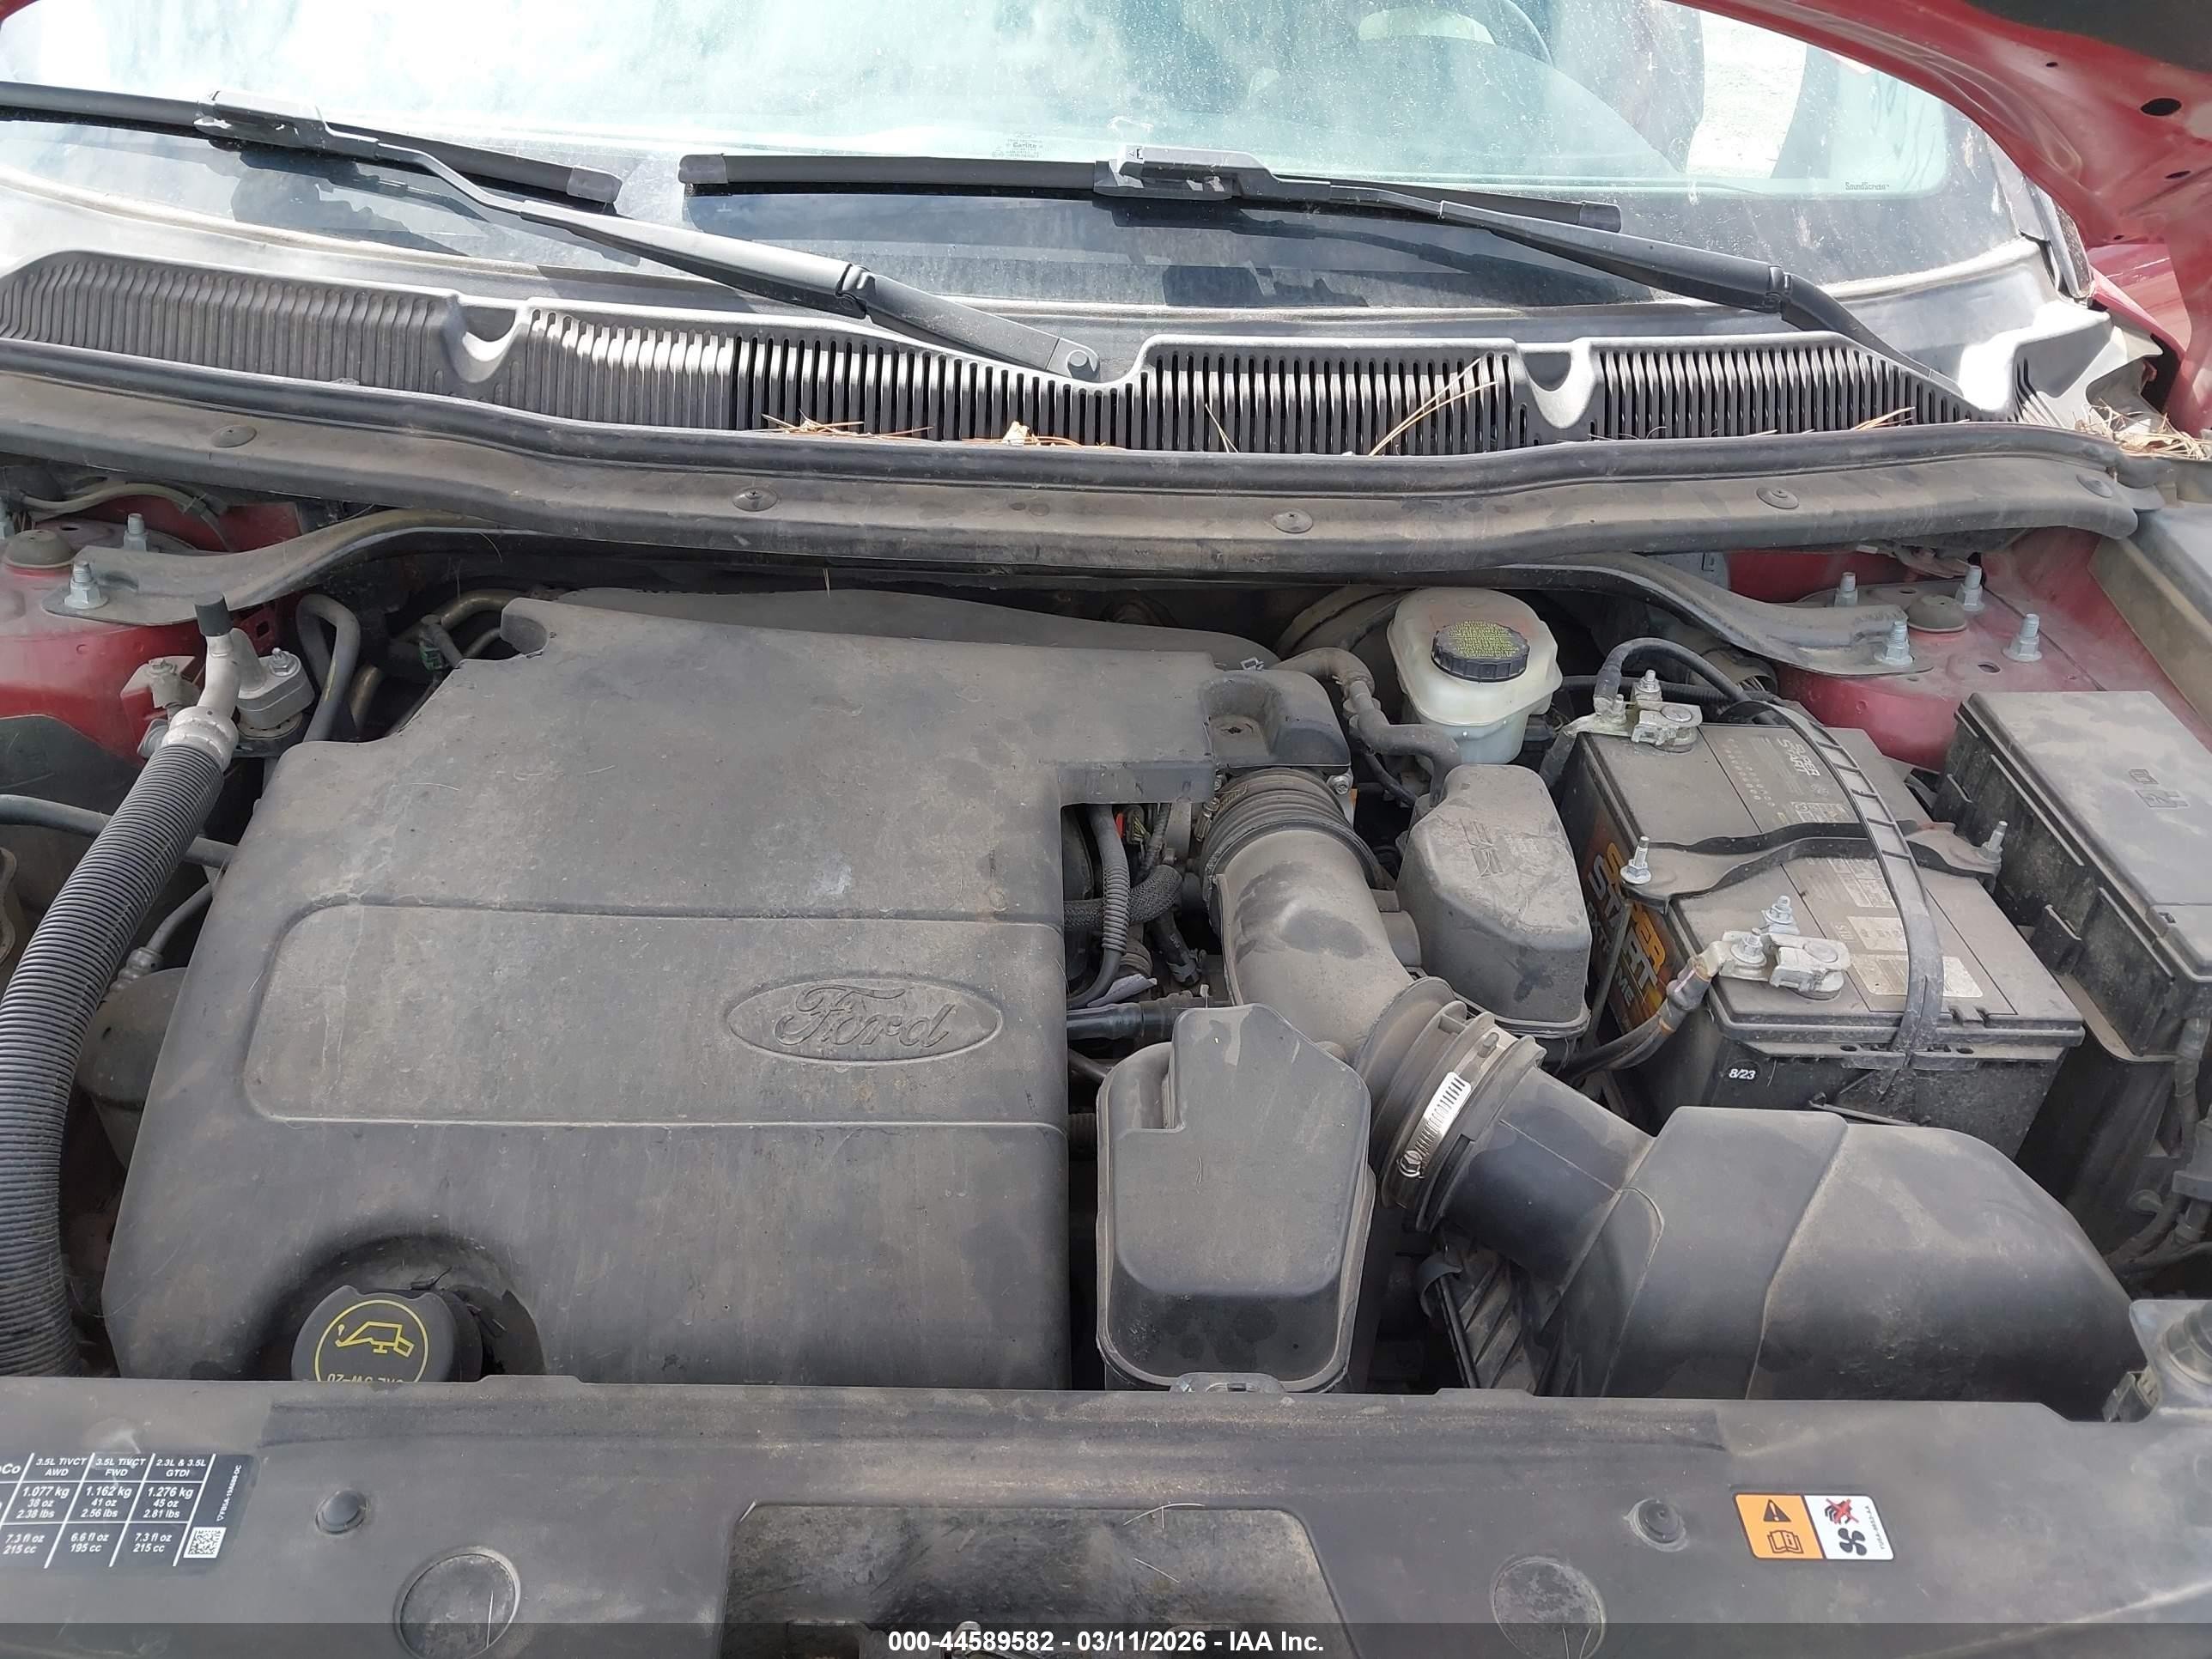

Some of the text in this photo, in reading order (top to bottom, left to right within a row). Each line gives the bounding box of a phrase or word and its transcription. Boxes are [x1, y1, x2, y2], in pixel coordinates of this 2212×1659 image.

[1777, 738, 1811, 776] START
[1796, 743, 1821, 776] SUPER
[774, 984, 956, 1048] Ford
[1729, 1068, 1756, 1079] 8/23
[105, 1468, 128, 1477] FWD
[22, 1486, 70, 1498] 1.077 kg
[86, 1486, 132, 1498] 1.162 kg
[147, 1486, 194, 1499] 1.276 kg
[27, 1498, 54, 1508] 38 oz
[91, 1498, 104, 1507] 41
[153, 1498, 166, 1508] 45
[15, 1509, 55, 1519] 2.38 lbs
[80, 1508, 118, 1518] 2.56 lbs
[143, 1509, 180, 1519] 2.81 lbs
[5, 1533, 45, 1544] 7.3 fl oz
[70, 1532, 110, 1542] 6.6 fl oz
[134, 1533, 149, 1542] 7.3
[150, 1533, 159, 1542] fl
[3, 1545, 37, 1555] 215 cc
[70, 1543, 88, 1553] 195
[132, 1543, 151, 1553] 215
